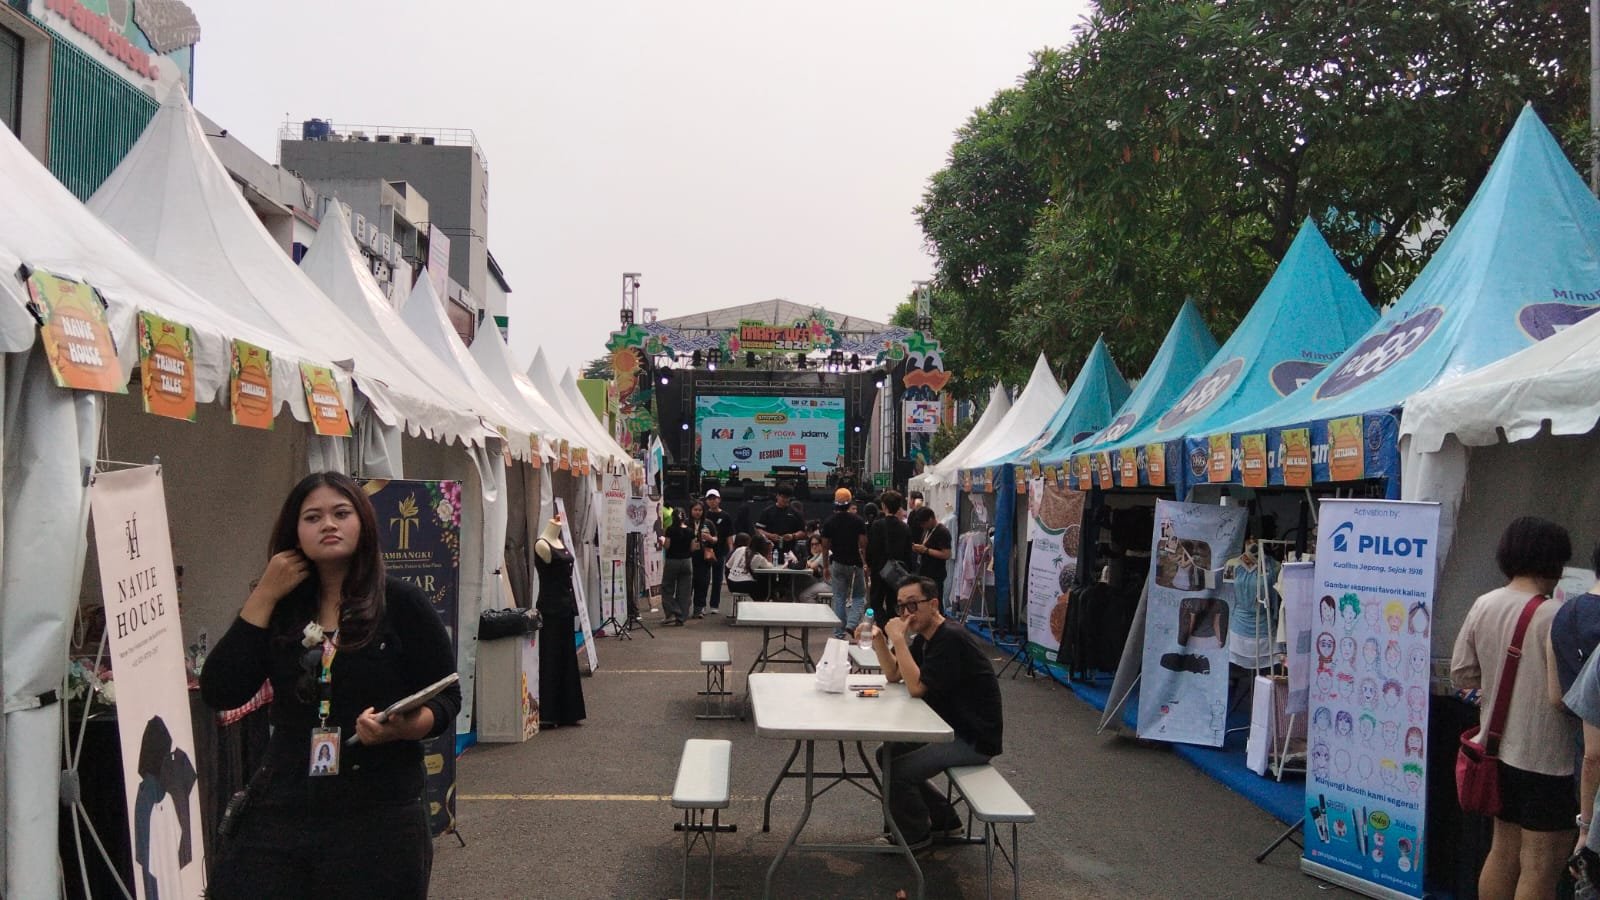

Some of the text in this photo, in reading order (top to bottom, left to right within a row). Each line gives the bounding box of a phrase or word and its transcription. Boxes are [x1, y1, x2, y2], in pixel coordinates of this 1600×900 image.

[67, 342, 103, 366] HOUSE
[161, 374, 182, 394] TALES
[1354, 508, 1389, 517] Activation
[1358, 534, 1428, 558] PILOT
[1333, 561, 1358, 570] Kualitas
[117, 566, 158, 603] NAVIE
[1323, 580, 1349, 590] Gambar
[1378, 585, 1401, 595] favorit
[116, 593, 165, 639] HOUSE
[1315, 775, 1345, 791] Kunjungi
[1346, 784, 1367, 797] booth
[1367, 790, 1386, 802] kami
